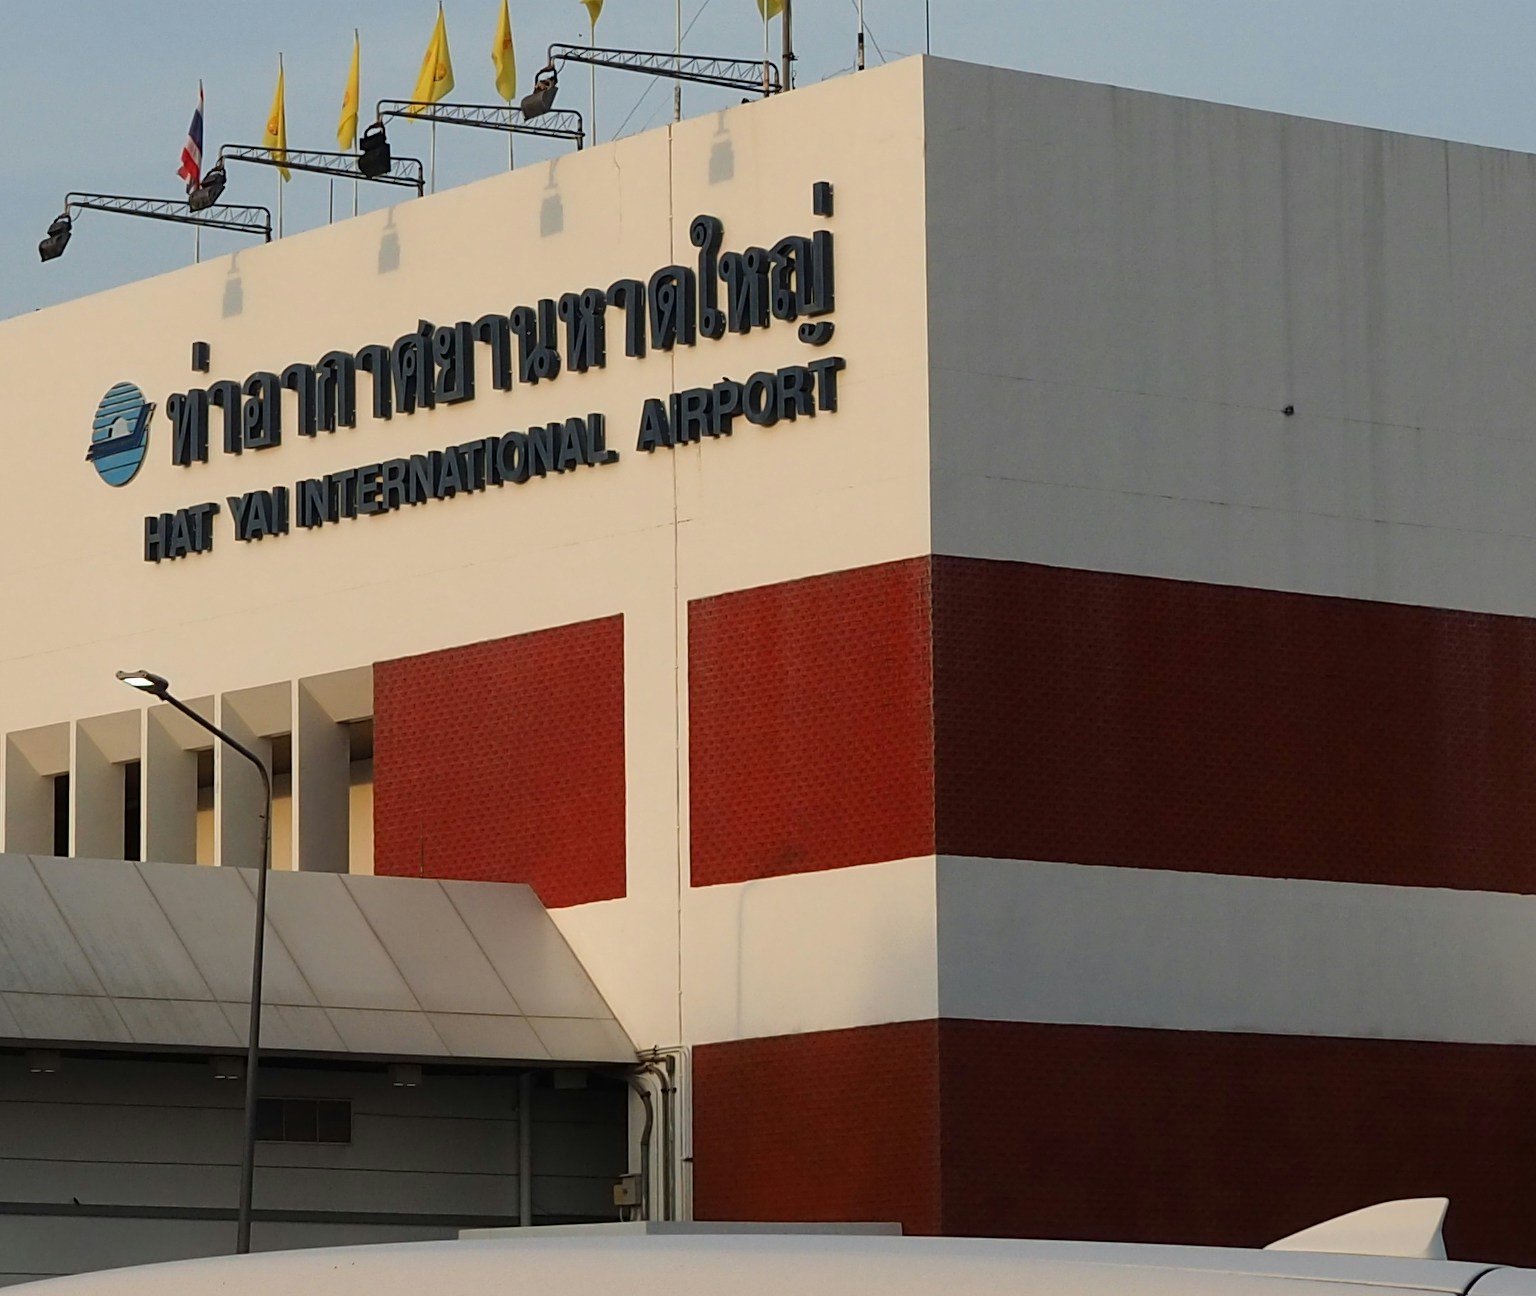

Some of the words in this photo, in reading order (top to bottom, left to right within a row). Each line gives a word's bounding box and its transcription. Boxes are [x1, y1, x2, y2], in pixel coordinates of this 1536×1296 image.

[166, 181, 835, 466] ท่าอากาศยานหาดใหญ่
[144, 502, 220, 563] HAT
[226, 486, 289, 542] YAI
[296, 413, 619, 529] INTERNATIONAL
[636, 356, 846, 453] AIRPORT
